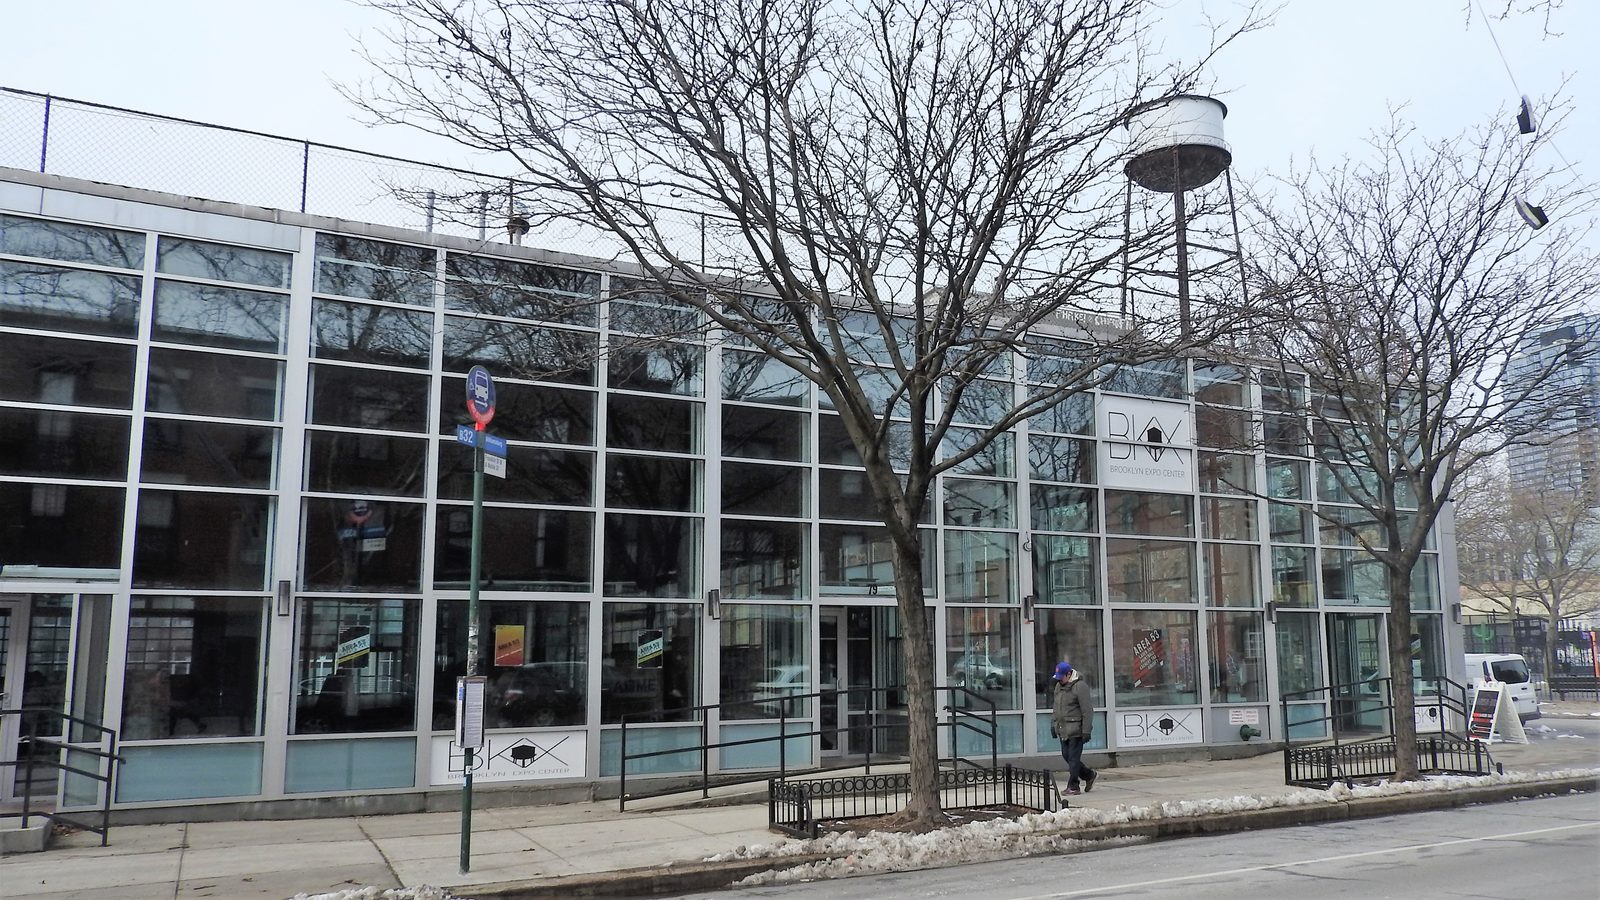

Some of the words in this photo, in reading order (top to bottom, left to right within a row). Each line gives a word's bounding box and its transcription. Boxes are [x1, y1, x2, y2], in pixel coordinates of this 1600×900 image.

[459, 429, 473, 443] B32
[1110, 465, 1143, 475] BROOKLYN
[1145, 468, 1161, 476] EXPO
[1163, 470, 1185, 478] CENTER
[868, 584, 878, 595] 79
[1133, 637, 1151, 656] AREA
